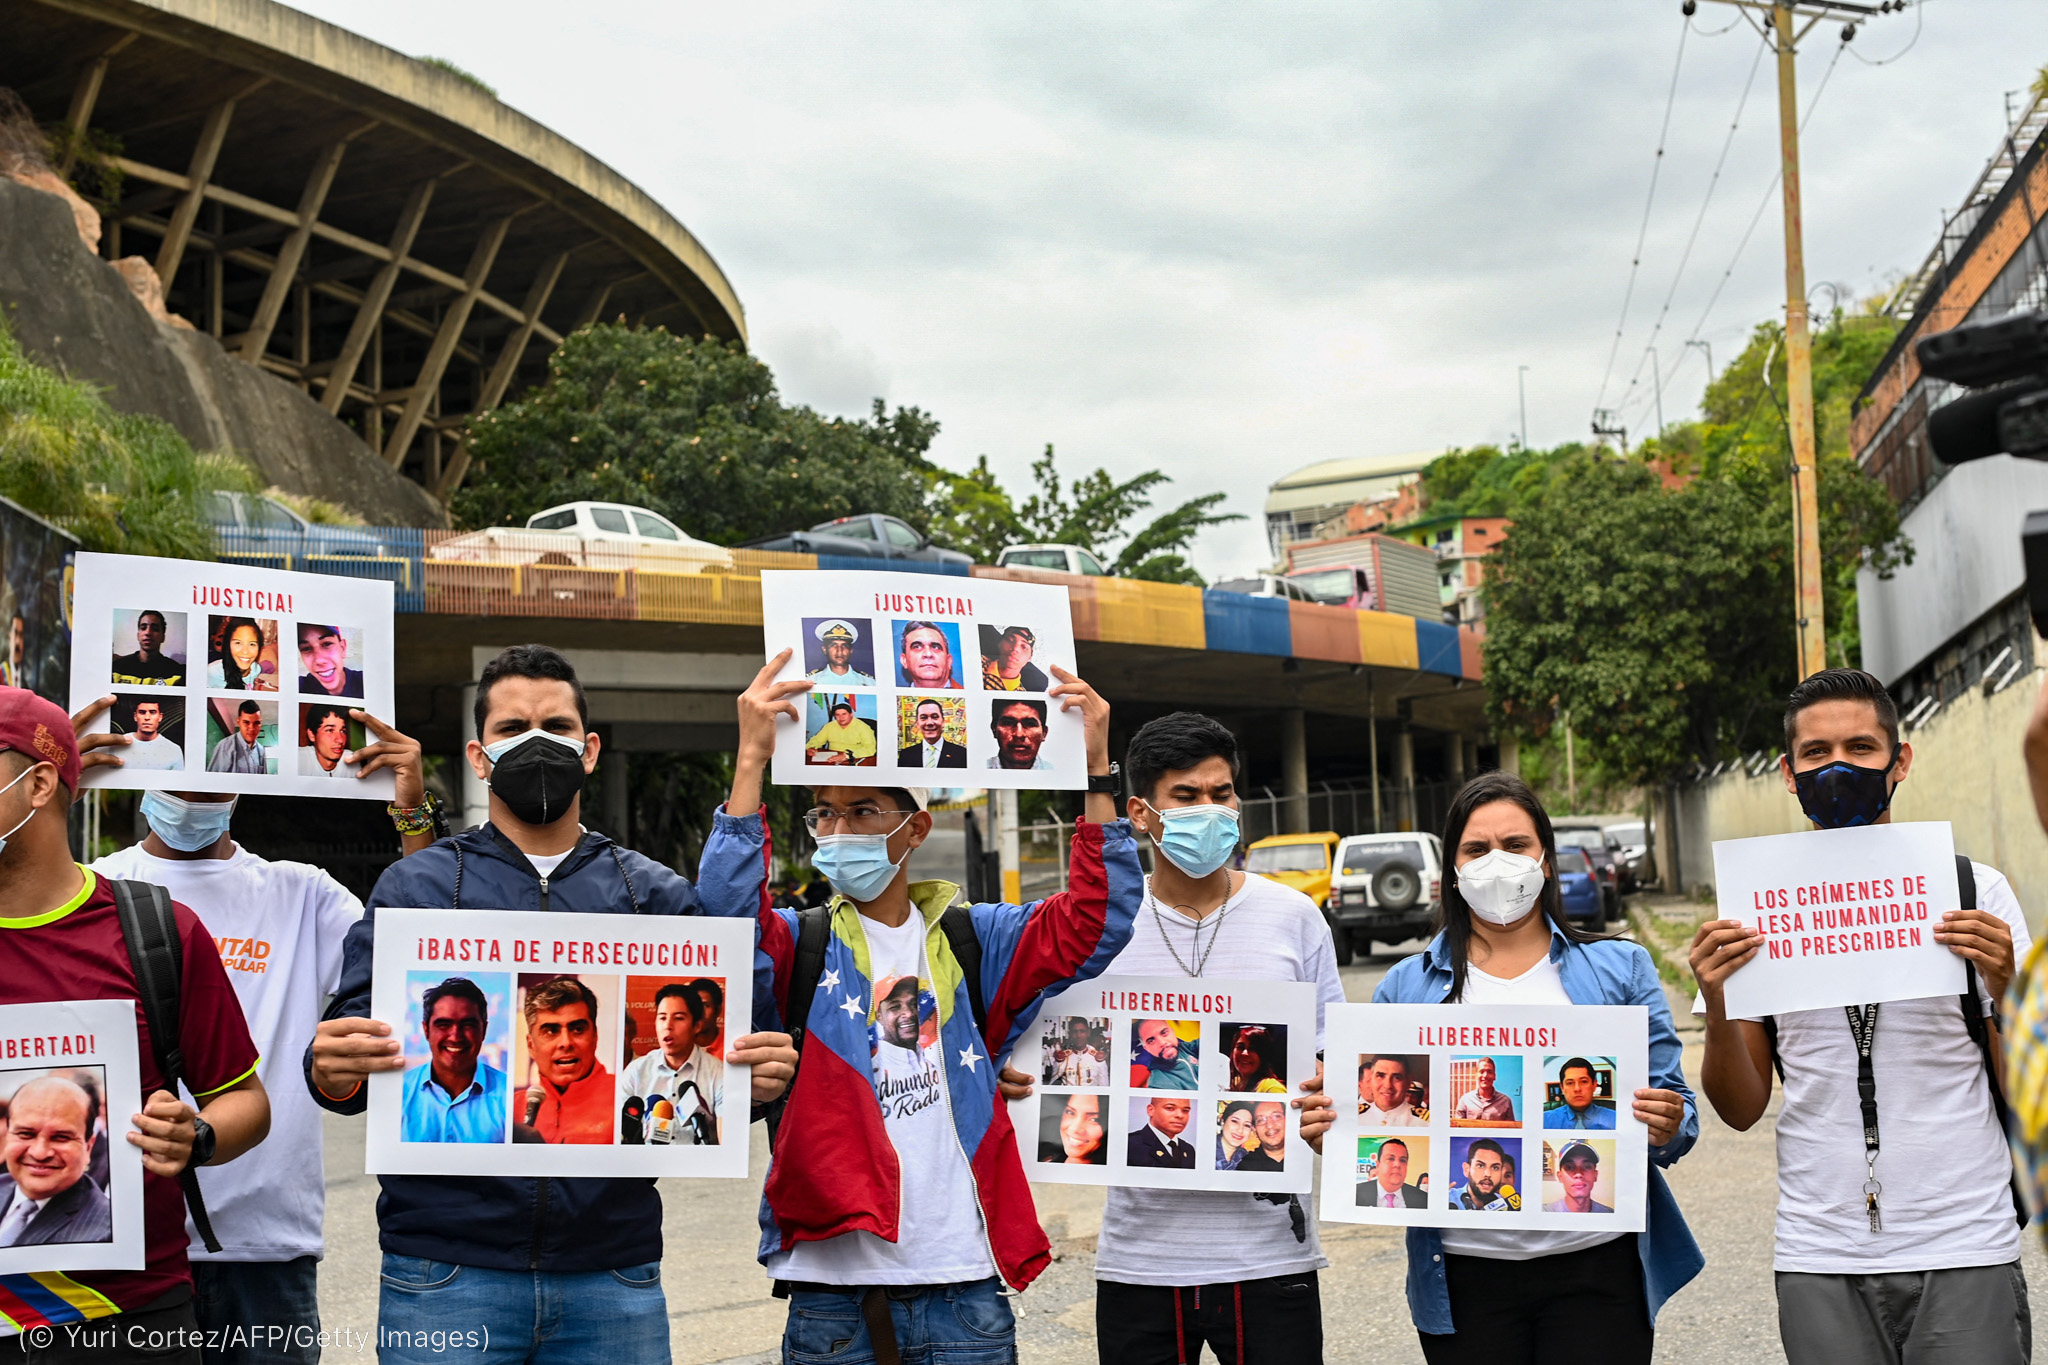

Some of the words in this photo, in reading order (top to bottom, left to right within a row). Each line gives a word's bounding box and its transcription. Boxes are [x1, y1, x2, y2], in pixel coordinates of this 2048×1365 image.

[192, 584, 293, 613] ¡JUSTICIA!
[874, 592, 973, 616] ¡JUSTICIA!
[1754, 888, 1788, 910] LOS
[1796, 878, 1894, 906] CRÍMENES
[1902, 875, 1927, 897] DE
[1757, 912, 1805, 935] LESA
[1812, 901, 1928, 931] HUMANIDAD
[417, 937, 502, 962] ¡BASTA
[513, 939, 541, 963] DE
[552, 939, 718, 967] PERSECUCIÓN!
[1768, 938, 1793, 960] NO
[1801, 927, 1922, 957] PRESCRIBEN
[221, 958, 267, 974] PULAR
[1101, 990, 1232, 1015] ¡LIBERENLOS!
[1418, 1026, 1557, 1048] ¡LIBERENLOS!
[878, 1062, 940, 1102] dmundo
[893, 1086, 940, 1120] Rada
